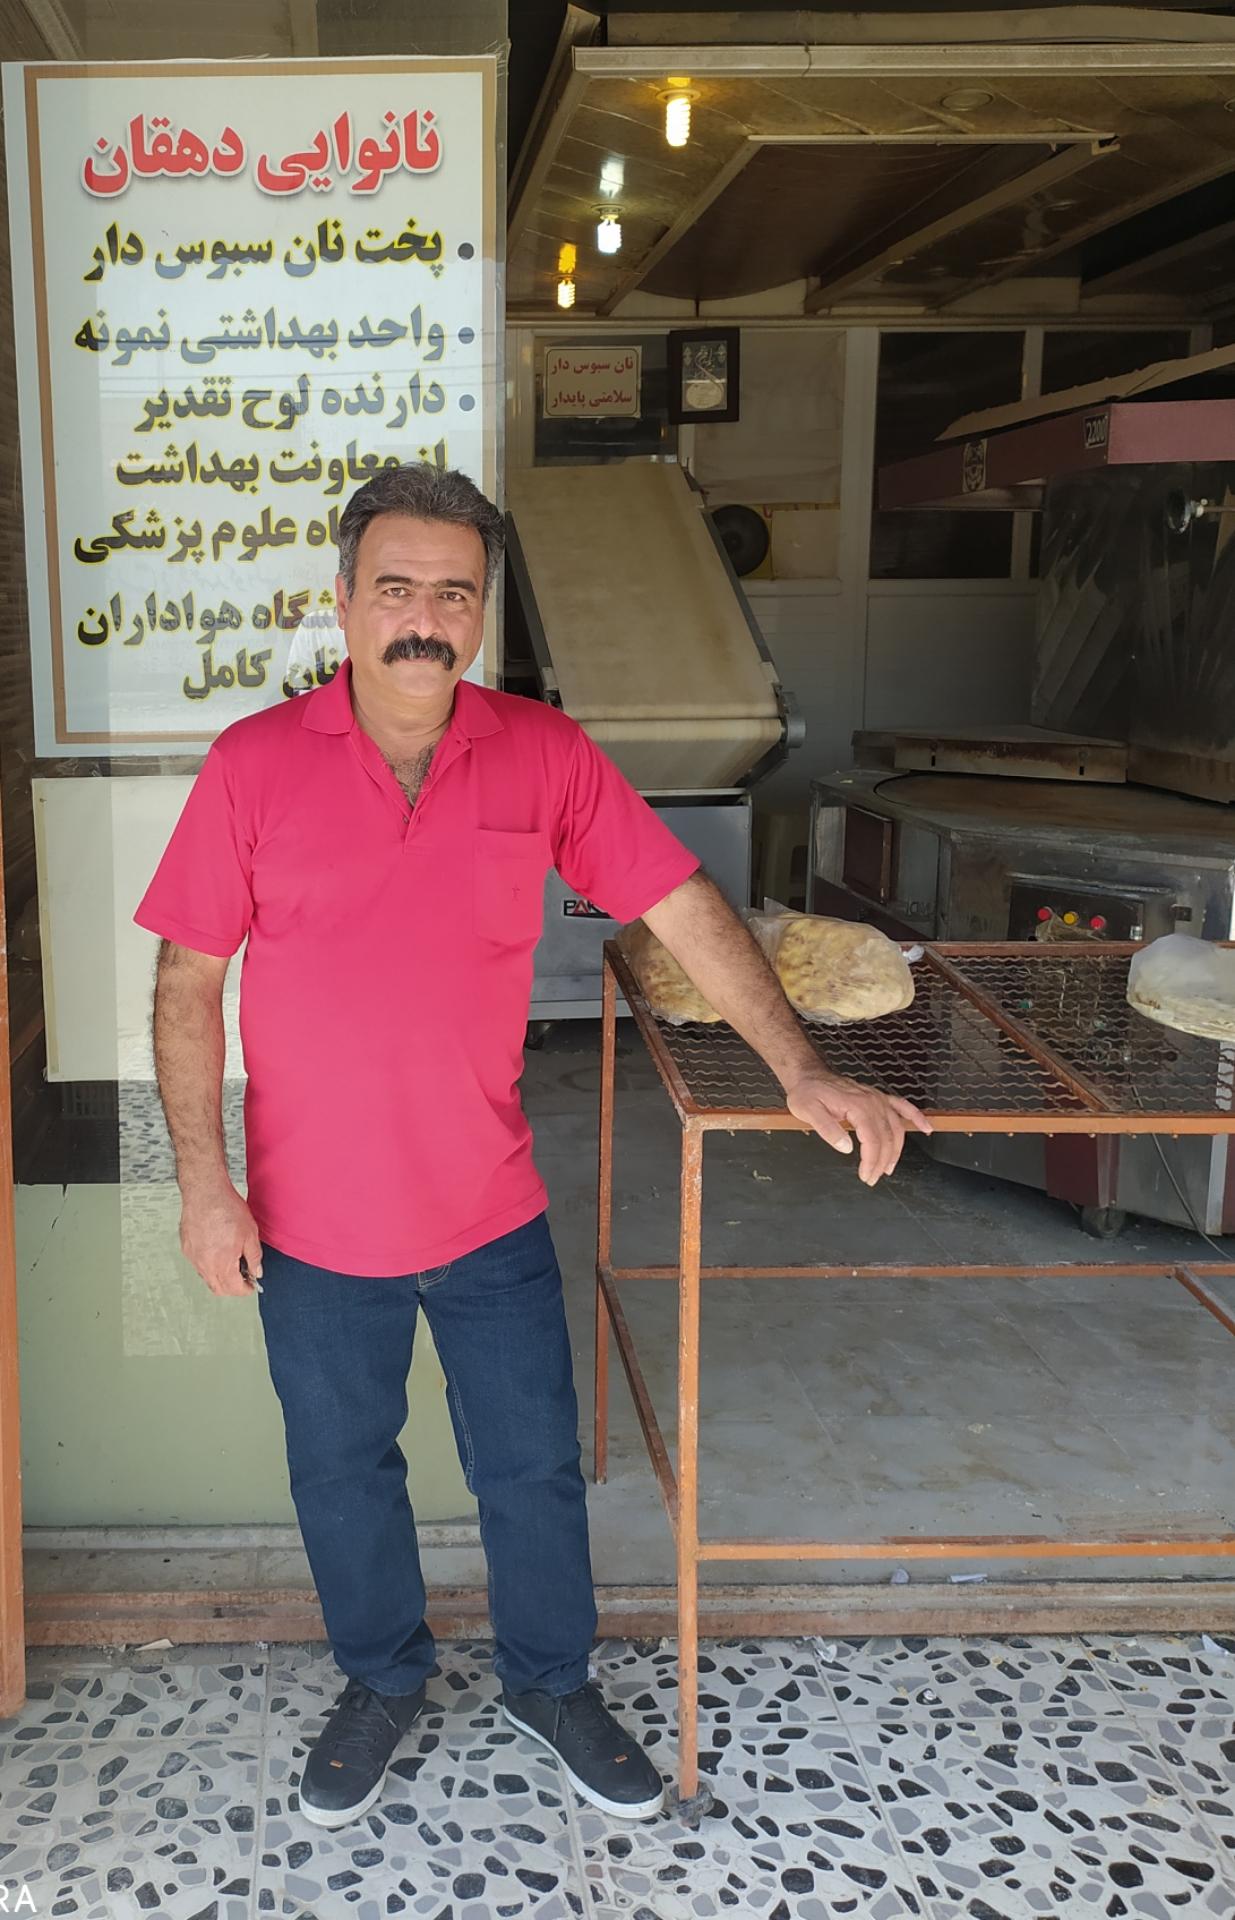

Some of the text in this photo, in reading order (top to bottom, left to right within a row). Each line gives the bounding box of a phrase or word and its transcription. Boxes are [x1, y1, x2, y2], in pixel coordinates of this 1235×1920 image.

[83, 110, 440, 194] نانوایی دهقان
[83, 218, 444, 281] پخت نان سبوس دار
[74, 304, 446, 366] واحد بهداشتی نمونه
[551, 355, 634, 375] نان سبوس دار
[134, 371, 446, 432] دارنده لوح تقدیر
[551, 389, 633, 408] سلامتی پایدار
[115, 441, 261, 494] بهداشت
[269, 440, 400, 495] معاونت
[73, 508, 202, 564] پزشکی
[211, 505, 297, 562] علوم
[76, 588, 338, 646] شگاه هواداران
[182, 648, 273, 701] کامل
